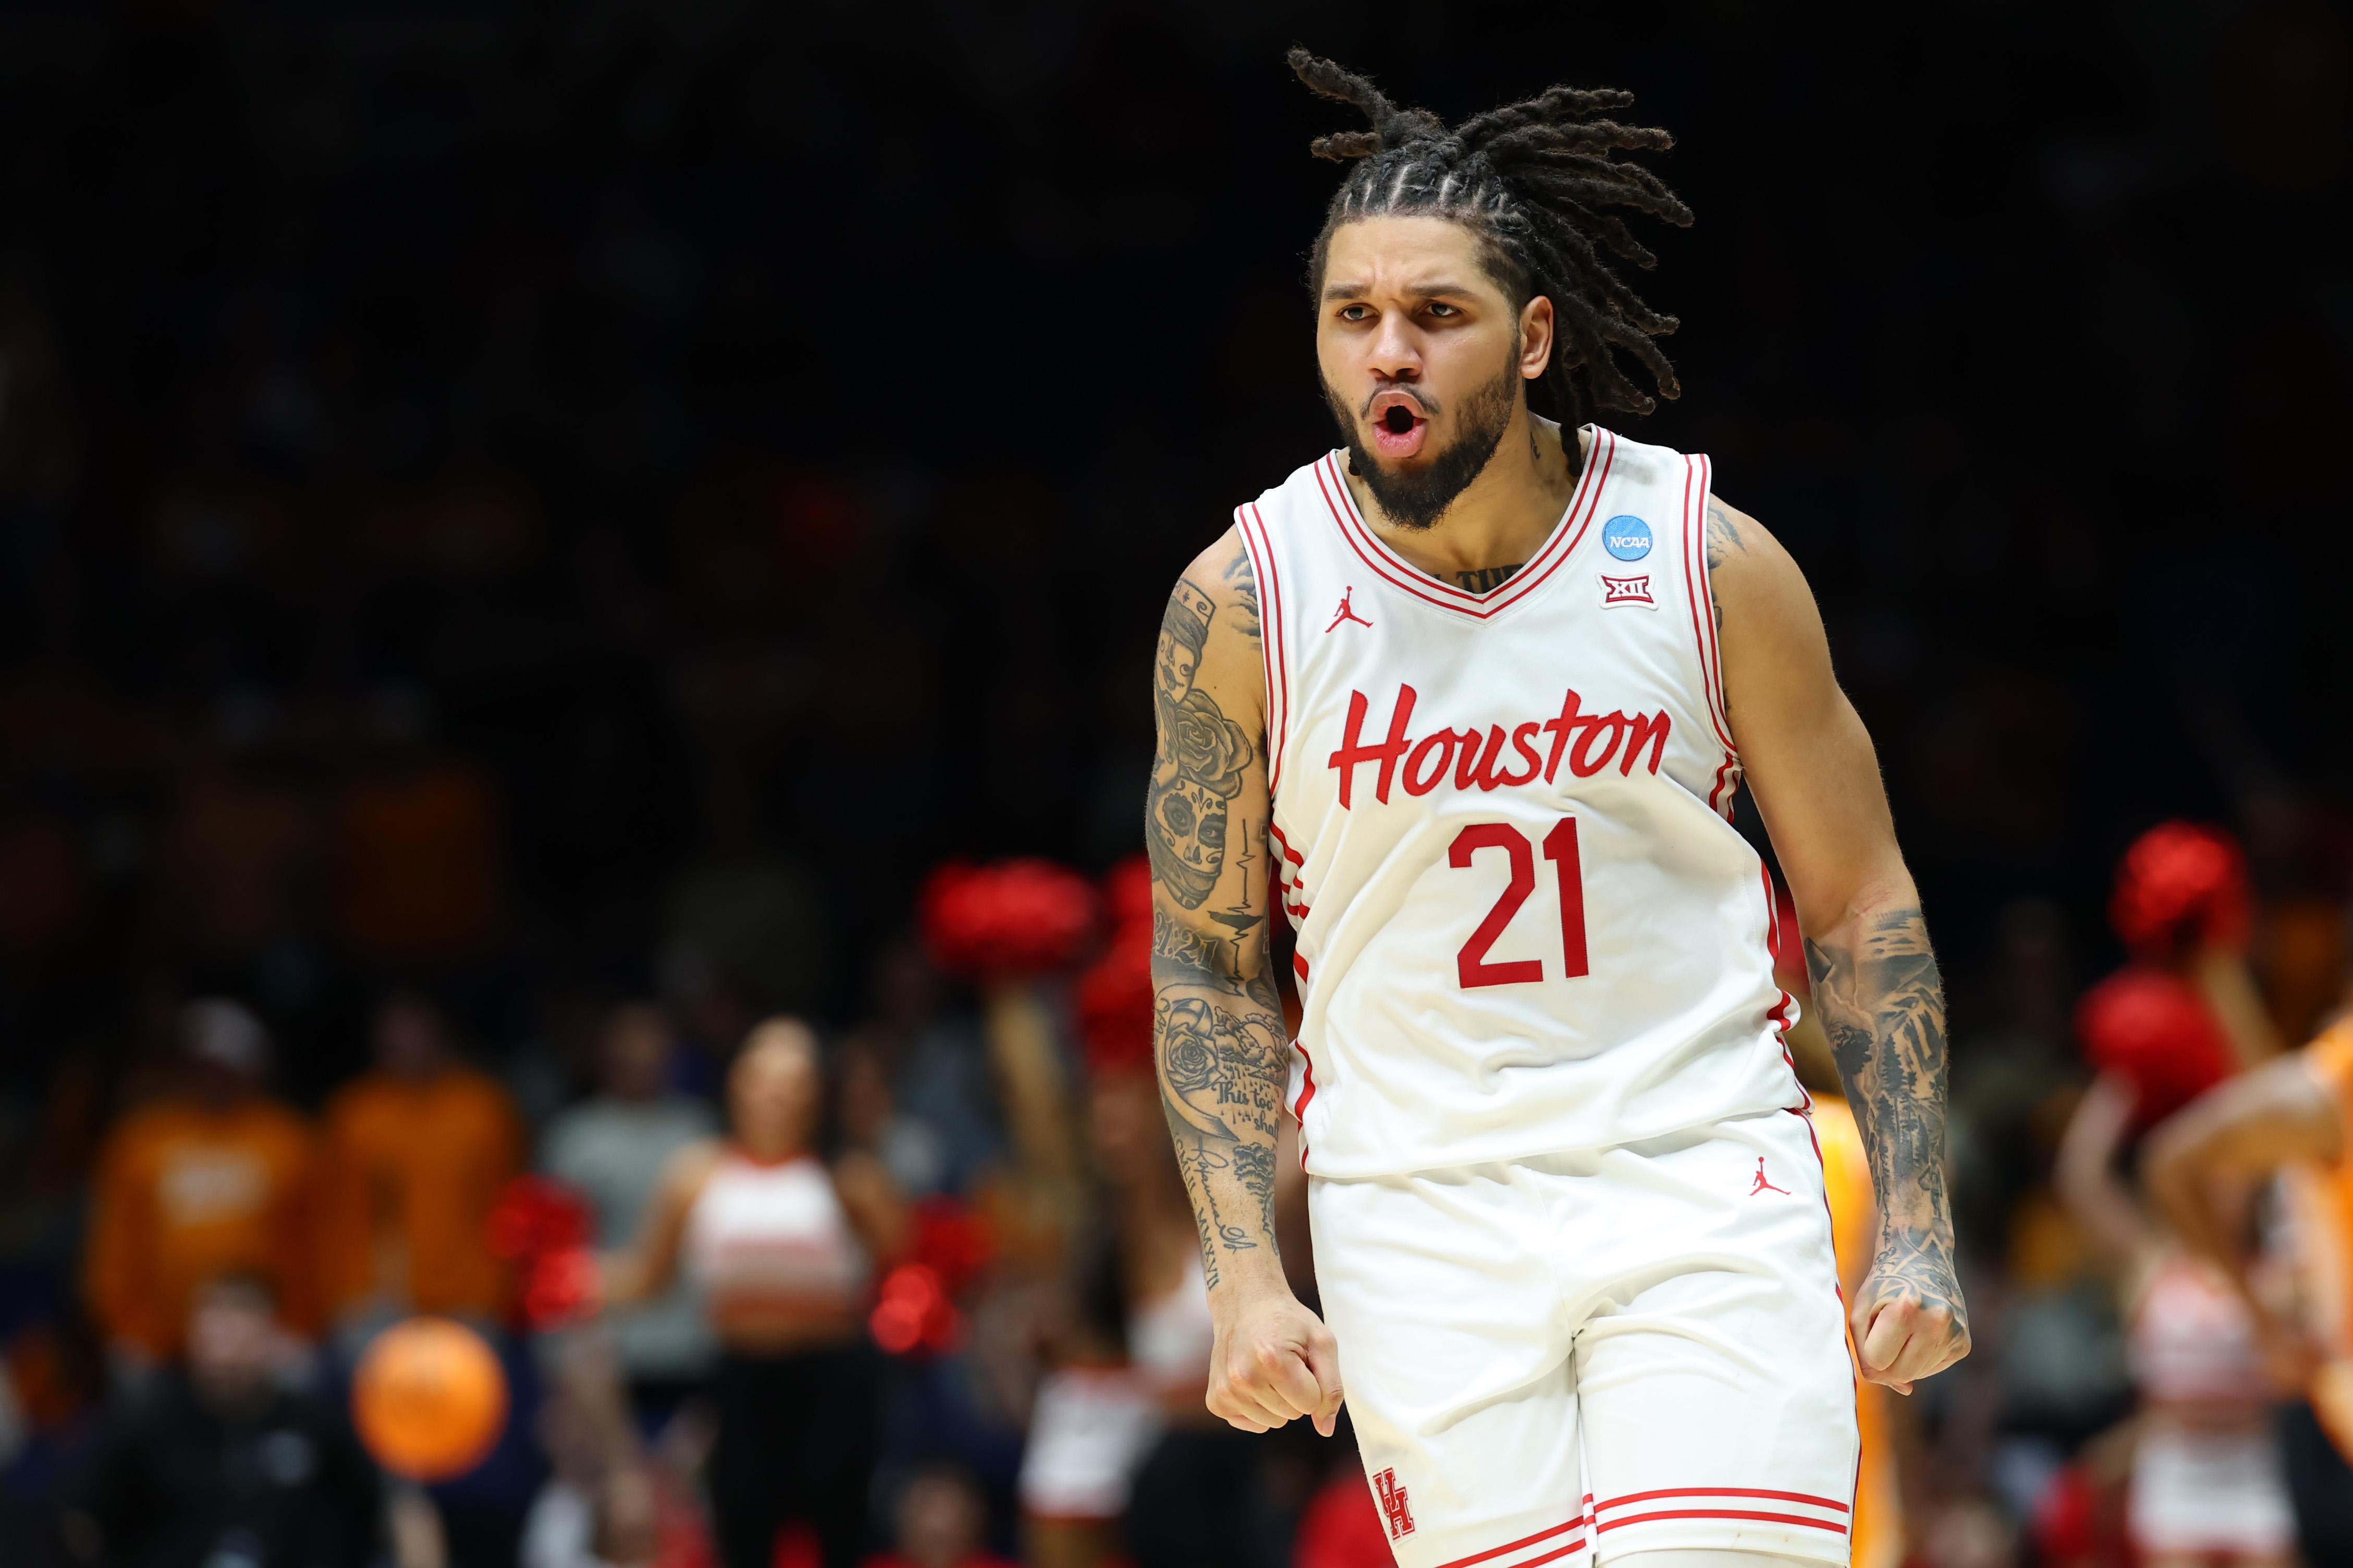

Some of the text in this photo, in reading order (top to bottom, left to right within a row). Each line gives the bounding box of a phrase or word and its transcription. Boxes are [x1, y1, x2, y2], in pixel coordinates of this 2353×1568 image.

[1609, 536, 1650, 548] NCAA
[1604, 577, 1652, 600] XII
[1327, 683, 1671, 811] Houston
[1448, 817, 1589, 989] 21
[1211, 1081, 1273, 1111] This too
